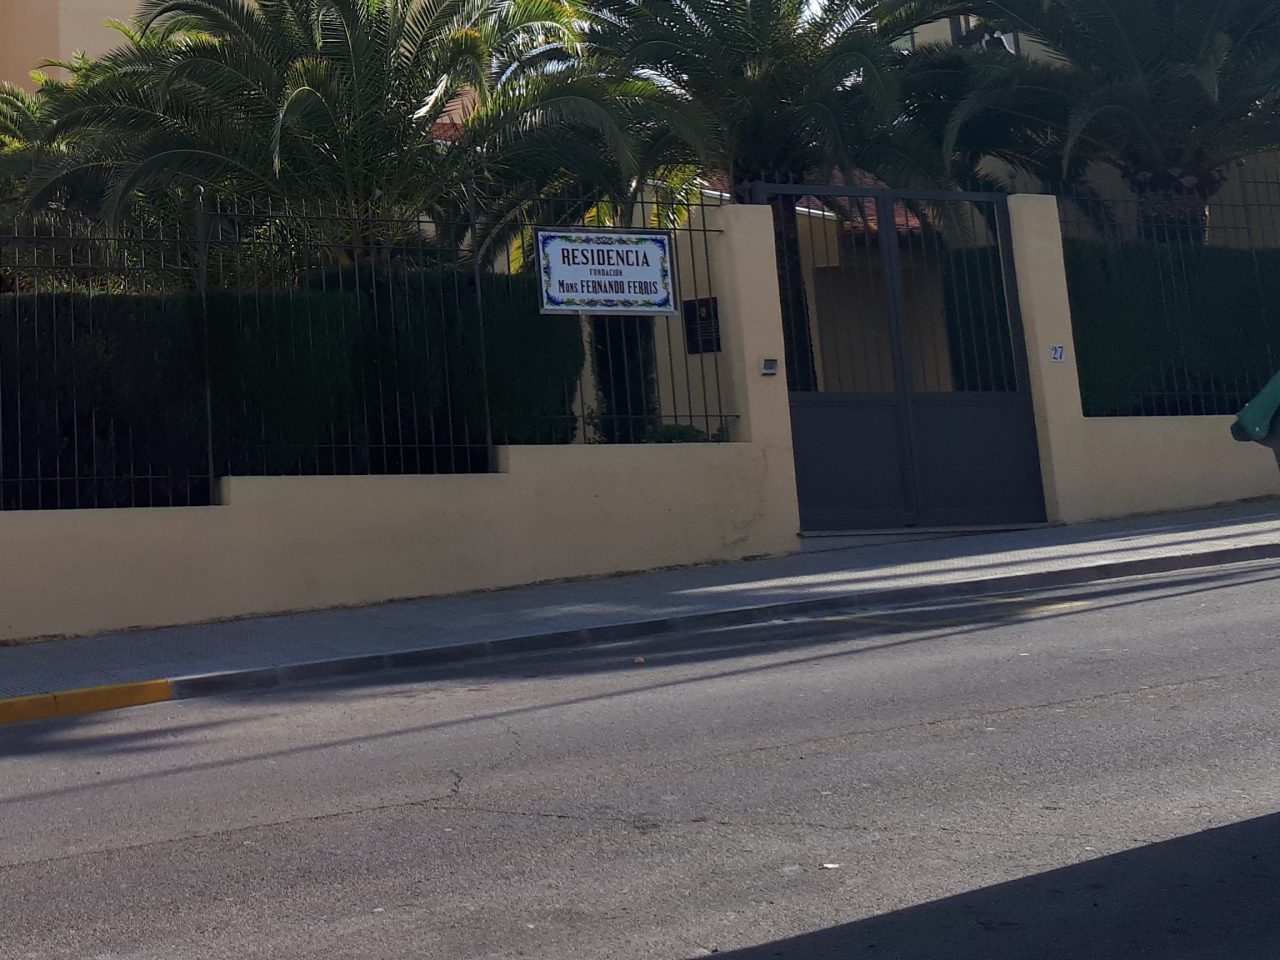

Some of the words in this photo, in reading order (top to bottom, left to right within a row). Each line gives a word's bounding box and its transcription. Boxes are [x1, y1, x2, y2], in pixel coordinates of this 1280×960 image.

[561, 248, 650, 267] RESIDENCIA
[580, 280, 625, 294] FERNANDO
[627, 281, 658, 295] FERRIS
[1051, 345, 1064, 360] 27
